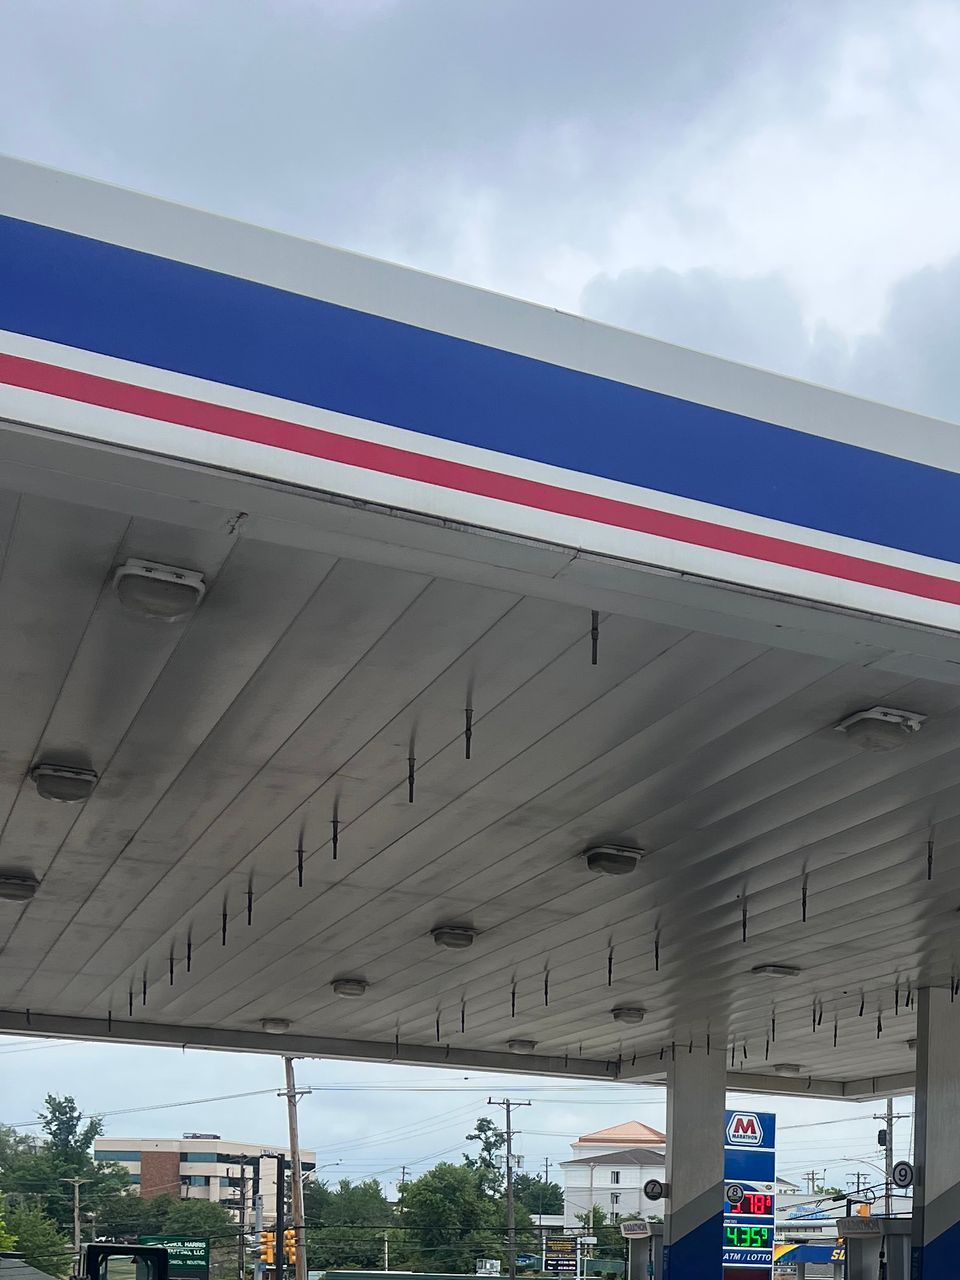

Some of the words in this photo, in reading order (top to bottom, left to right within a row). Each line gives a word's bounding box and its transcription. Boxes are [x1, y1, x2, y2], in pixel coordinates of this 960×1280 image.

[733, 1118, 757, 1134] M
[898, 1167, 908, 1182] 9
[650, 1183, 657, 1192] 7
[731, 1187, 739, 1196] 8
[722, 1253, 741, 1261] ATM
[747, 1254, 772, 1262] LOTTO
